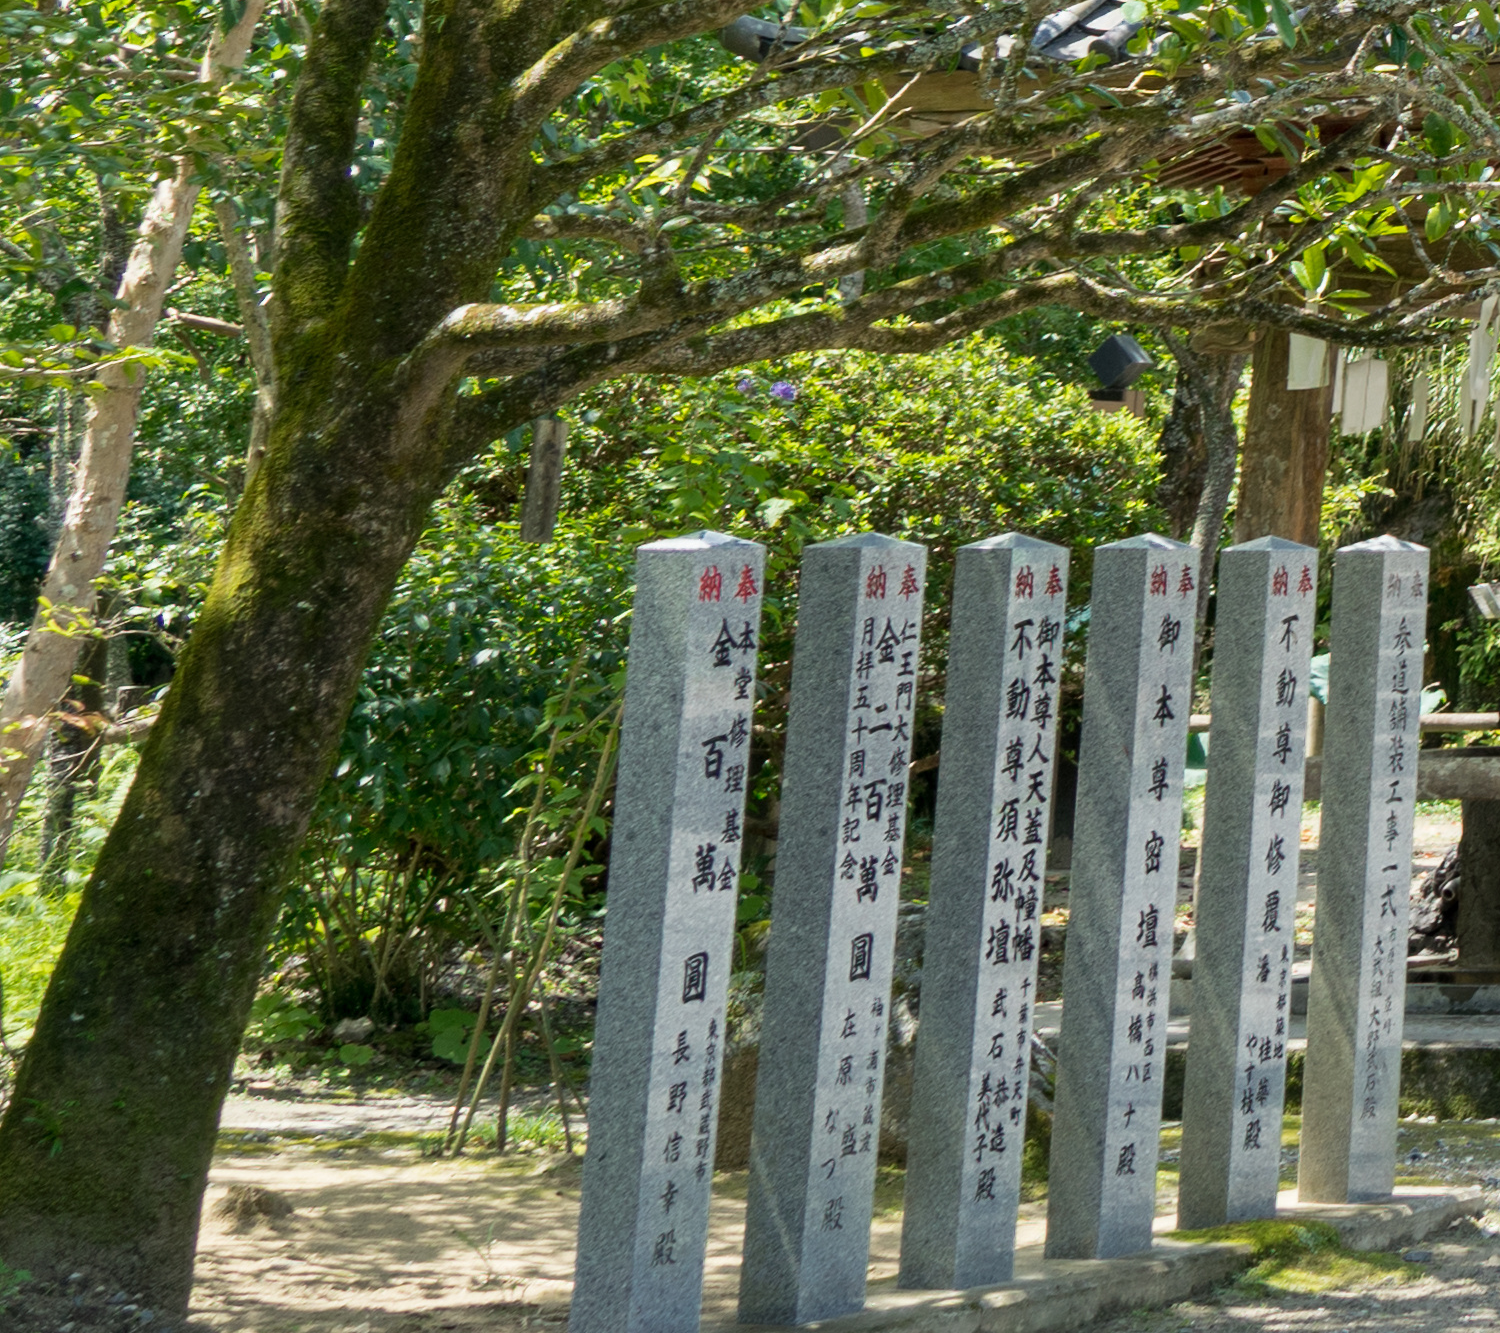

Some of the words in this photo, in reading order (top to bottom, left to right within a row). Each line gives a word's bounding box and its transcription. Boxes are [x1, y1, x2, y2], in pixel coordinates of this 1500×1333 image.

[699, 564, 758, 604] 奉納
[866, 564, 919, 601] 奉納
[1014, 564, 1063, 600] 奉納
[1150, 563, 1194, 599] 奉納
[1270, 564, 1314, 599] 奉納
[682, 618, 737, 1005] 金百萬圓
[717, 621, 757, 891] 本堂修理基金
[839, 617, 875, 881] 月拝五十周年記念
[850, 617, 899, 982] 金二百萬圓
[881, 618, 917, 877] 仁王門大修理基金
[987, 618, 1034, 965] 不動尊須弥壇
[1136, 612, 1181, 948] 御本尊密壇
[653, 1030, 690, 1267] 長野信幸殿
